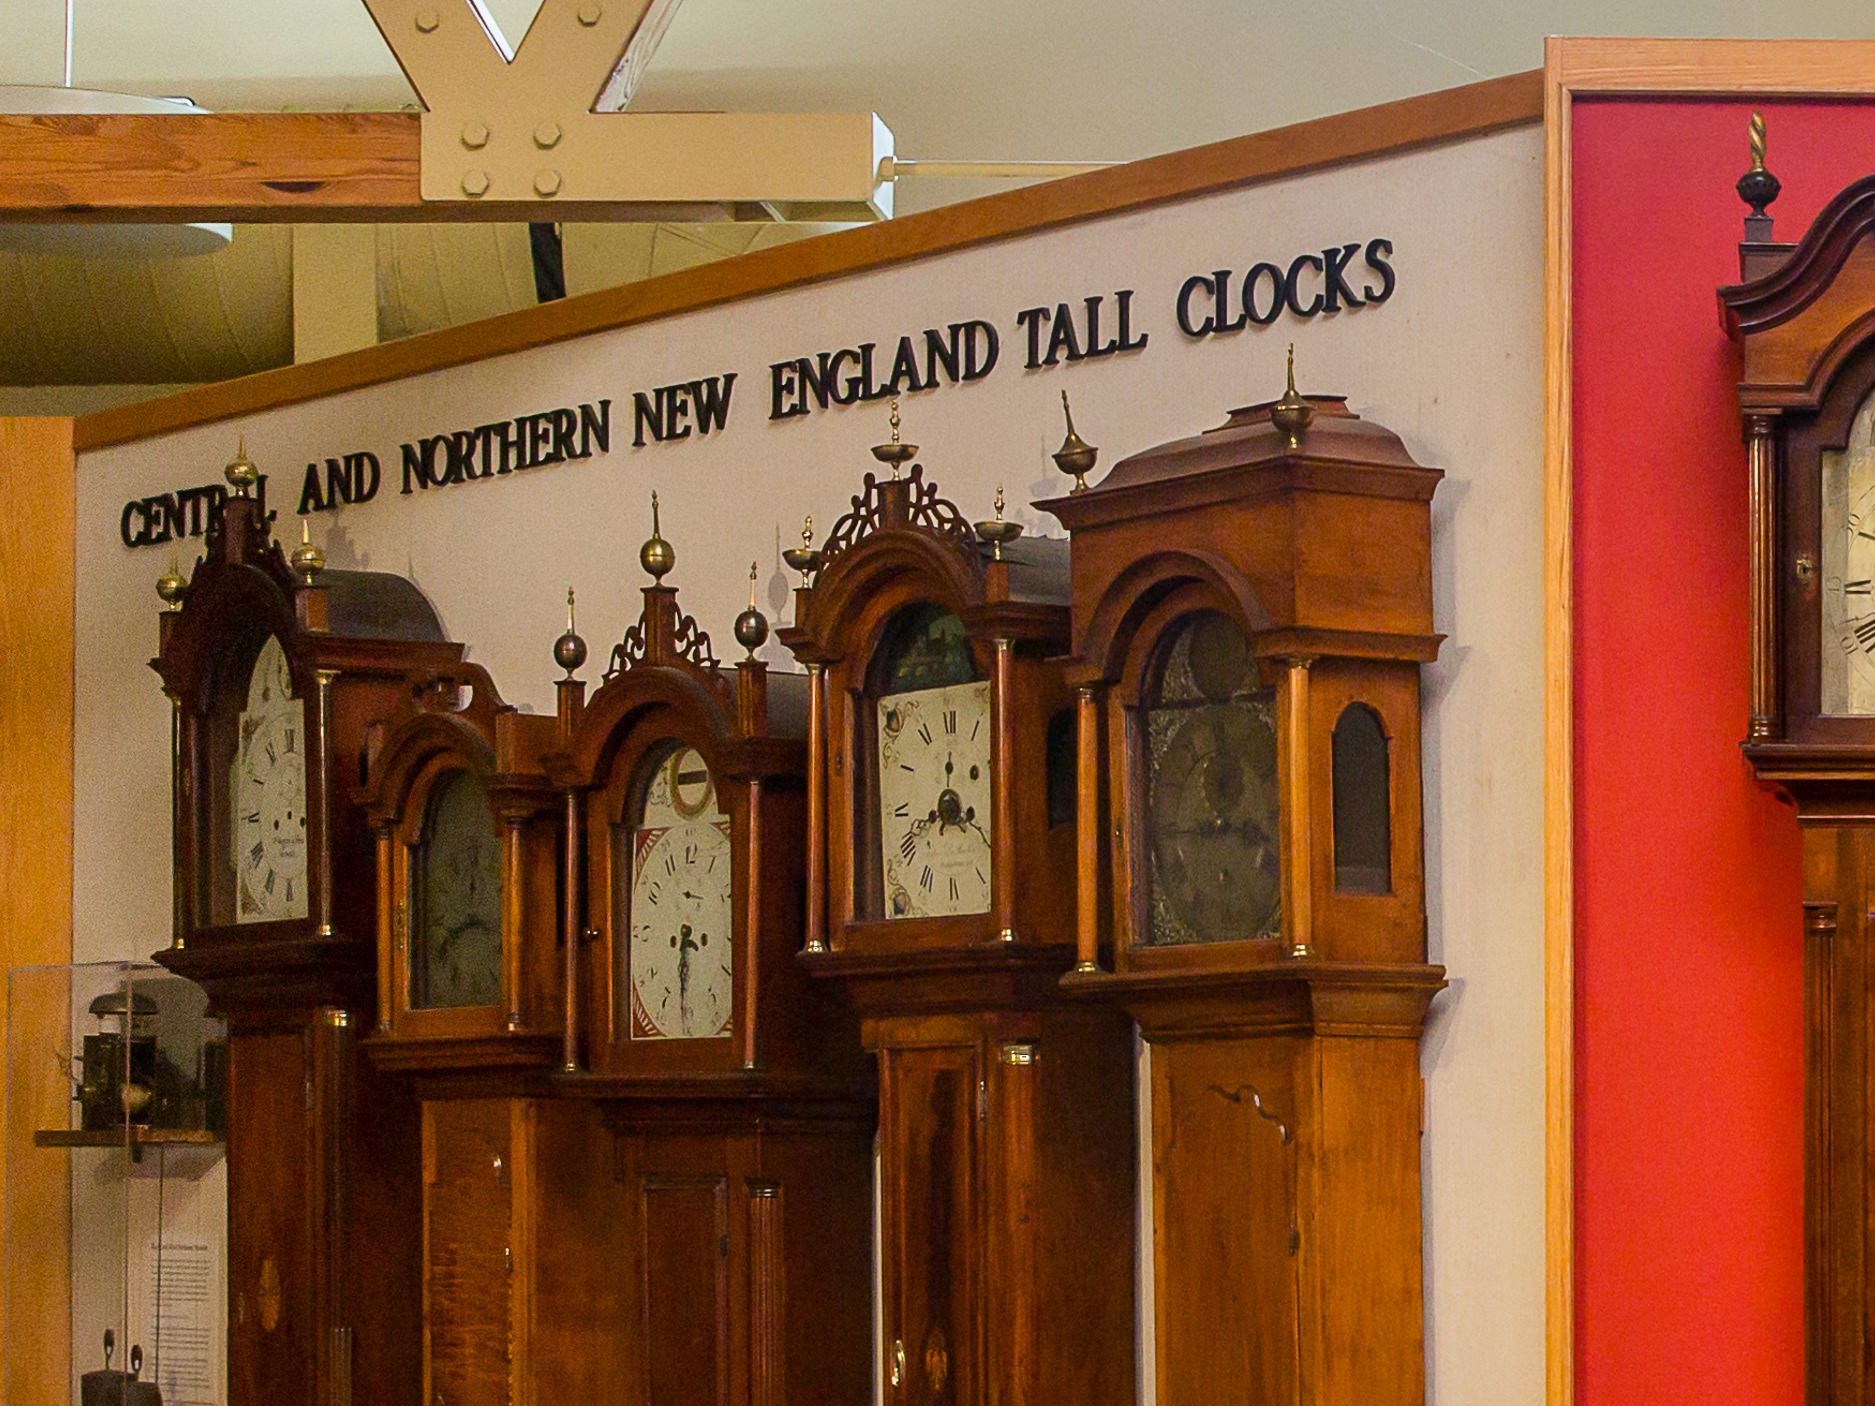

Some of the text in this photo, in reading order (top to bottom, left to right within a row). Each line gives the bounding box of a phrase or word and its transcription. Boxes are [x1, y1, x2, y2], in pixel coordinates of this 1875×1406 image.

[121, 239, 1396, 548] CENTRL AND NORTHERN NEW ENGLAND TALL CLOCKS
